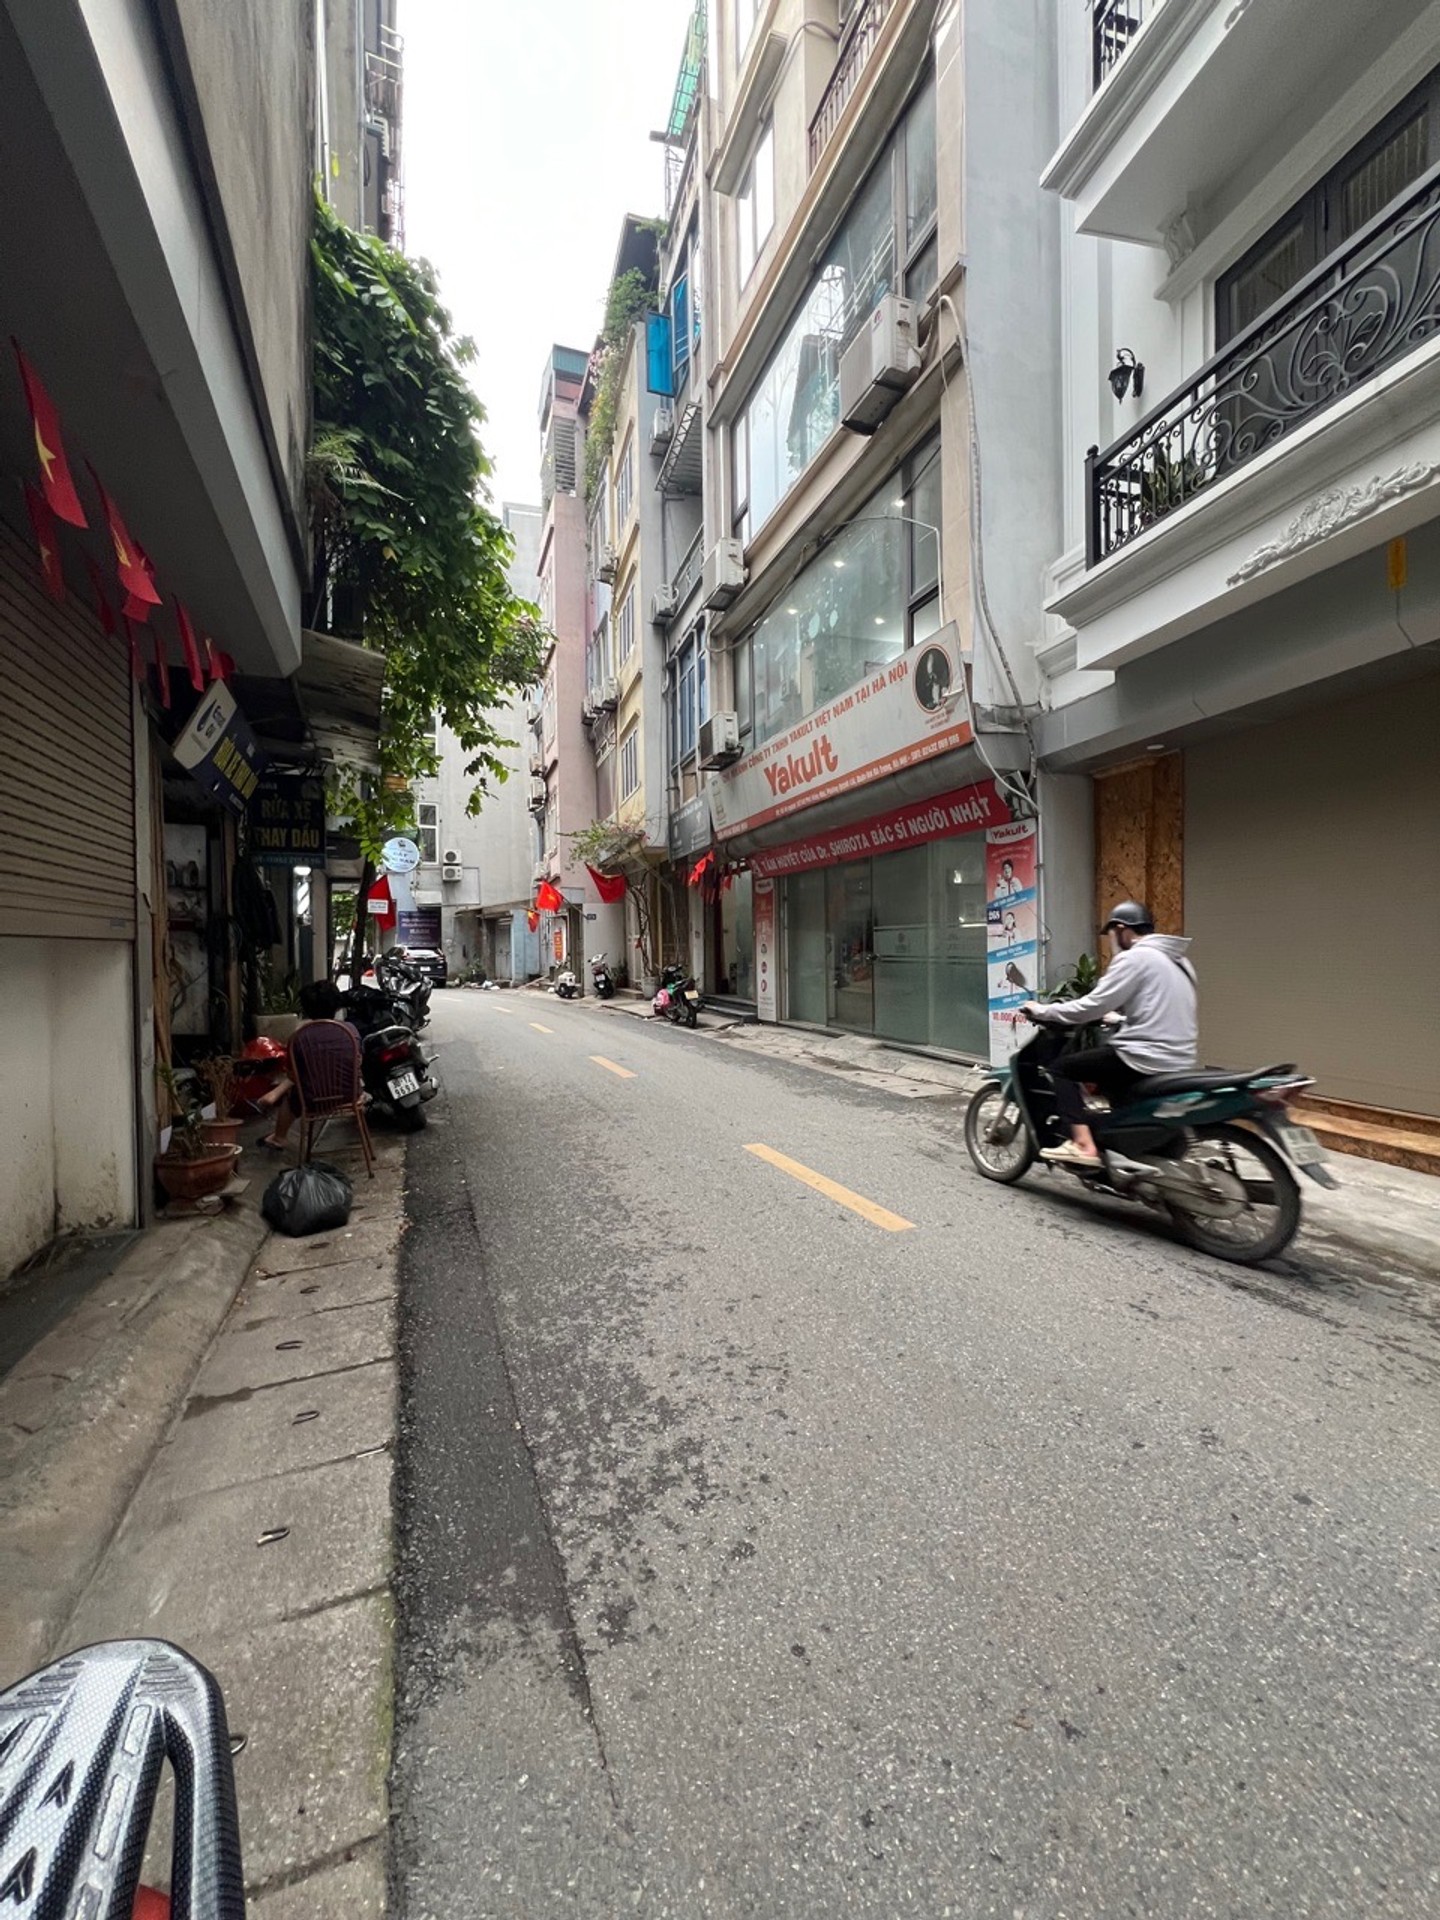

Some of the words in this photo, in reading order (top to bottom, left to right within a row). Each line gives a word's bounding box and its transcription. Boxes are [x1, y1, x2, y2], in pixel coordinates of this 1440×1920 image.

[763, 748, 771, 759] TY
[789, 721, 813, 742] YAKULT
[815, 709, 831, 728] VIỆT
[833, 696, 854, 718] NAM
[855, 685, 870, 703] TẠI
[872, 672, 886, 694] HÀ
[888, 661, 908, 684] NỘI
[763, 734, 839, 797] Yakult
[293, 801, 312, 820] XE
[829, 833, 871, 857] SHIROTA
[870, 824, 894, 845] BÁC
[908, 806, 950, 836] NGƯỜI
[949, 796, 991, 825] NHẬT
[993, 824, 1029, 839] Yakult
